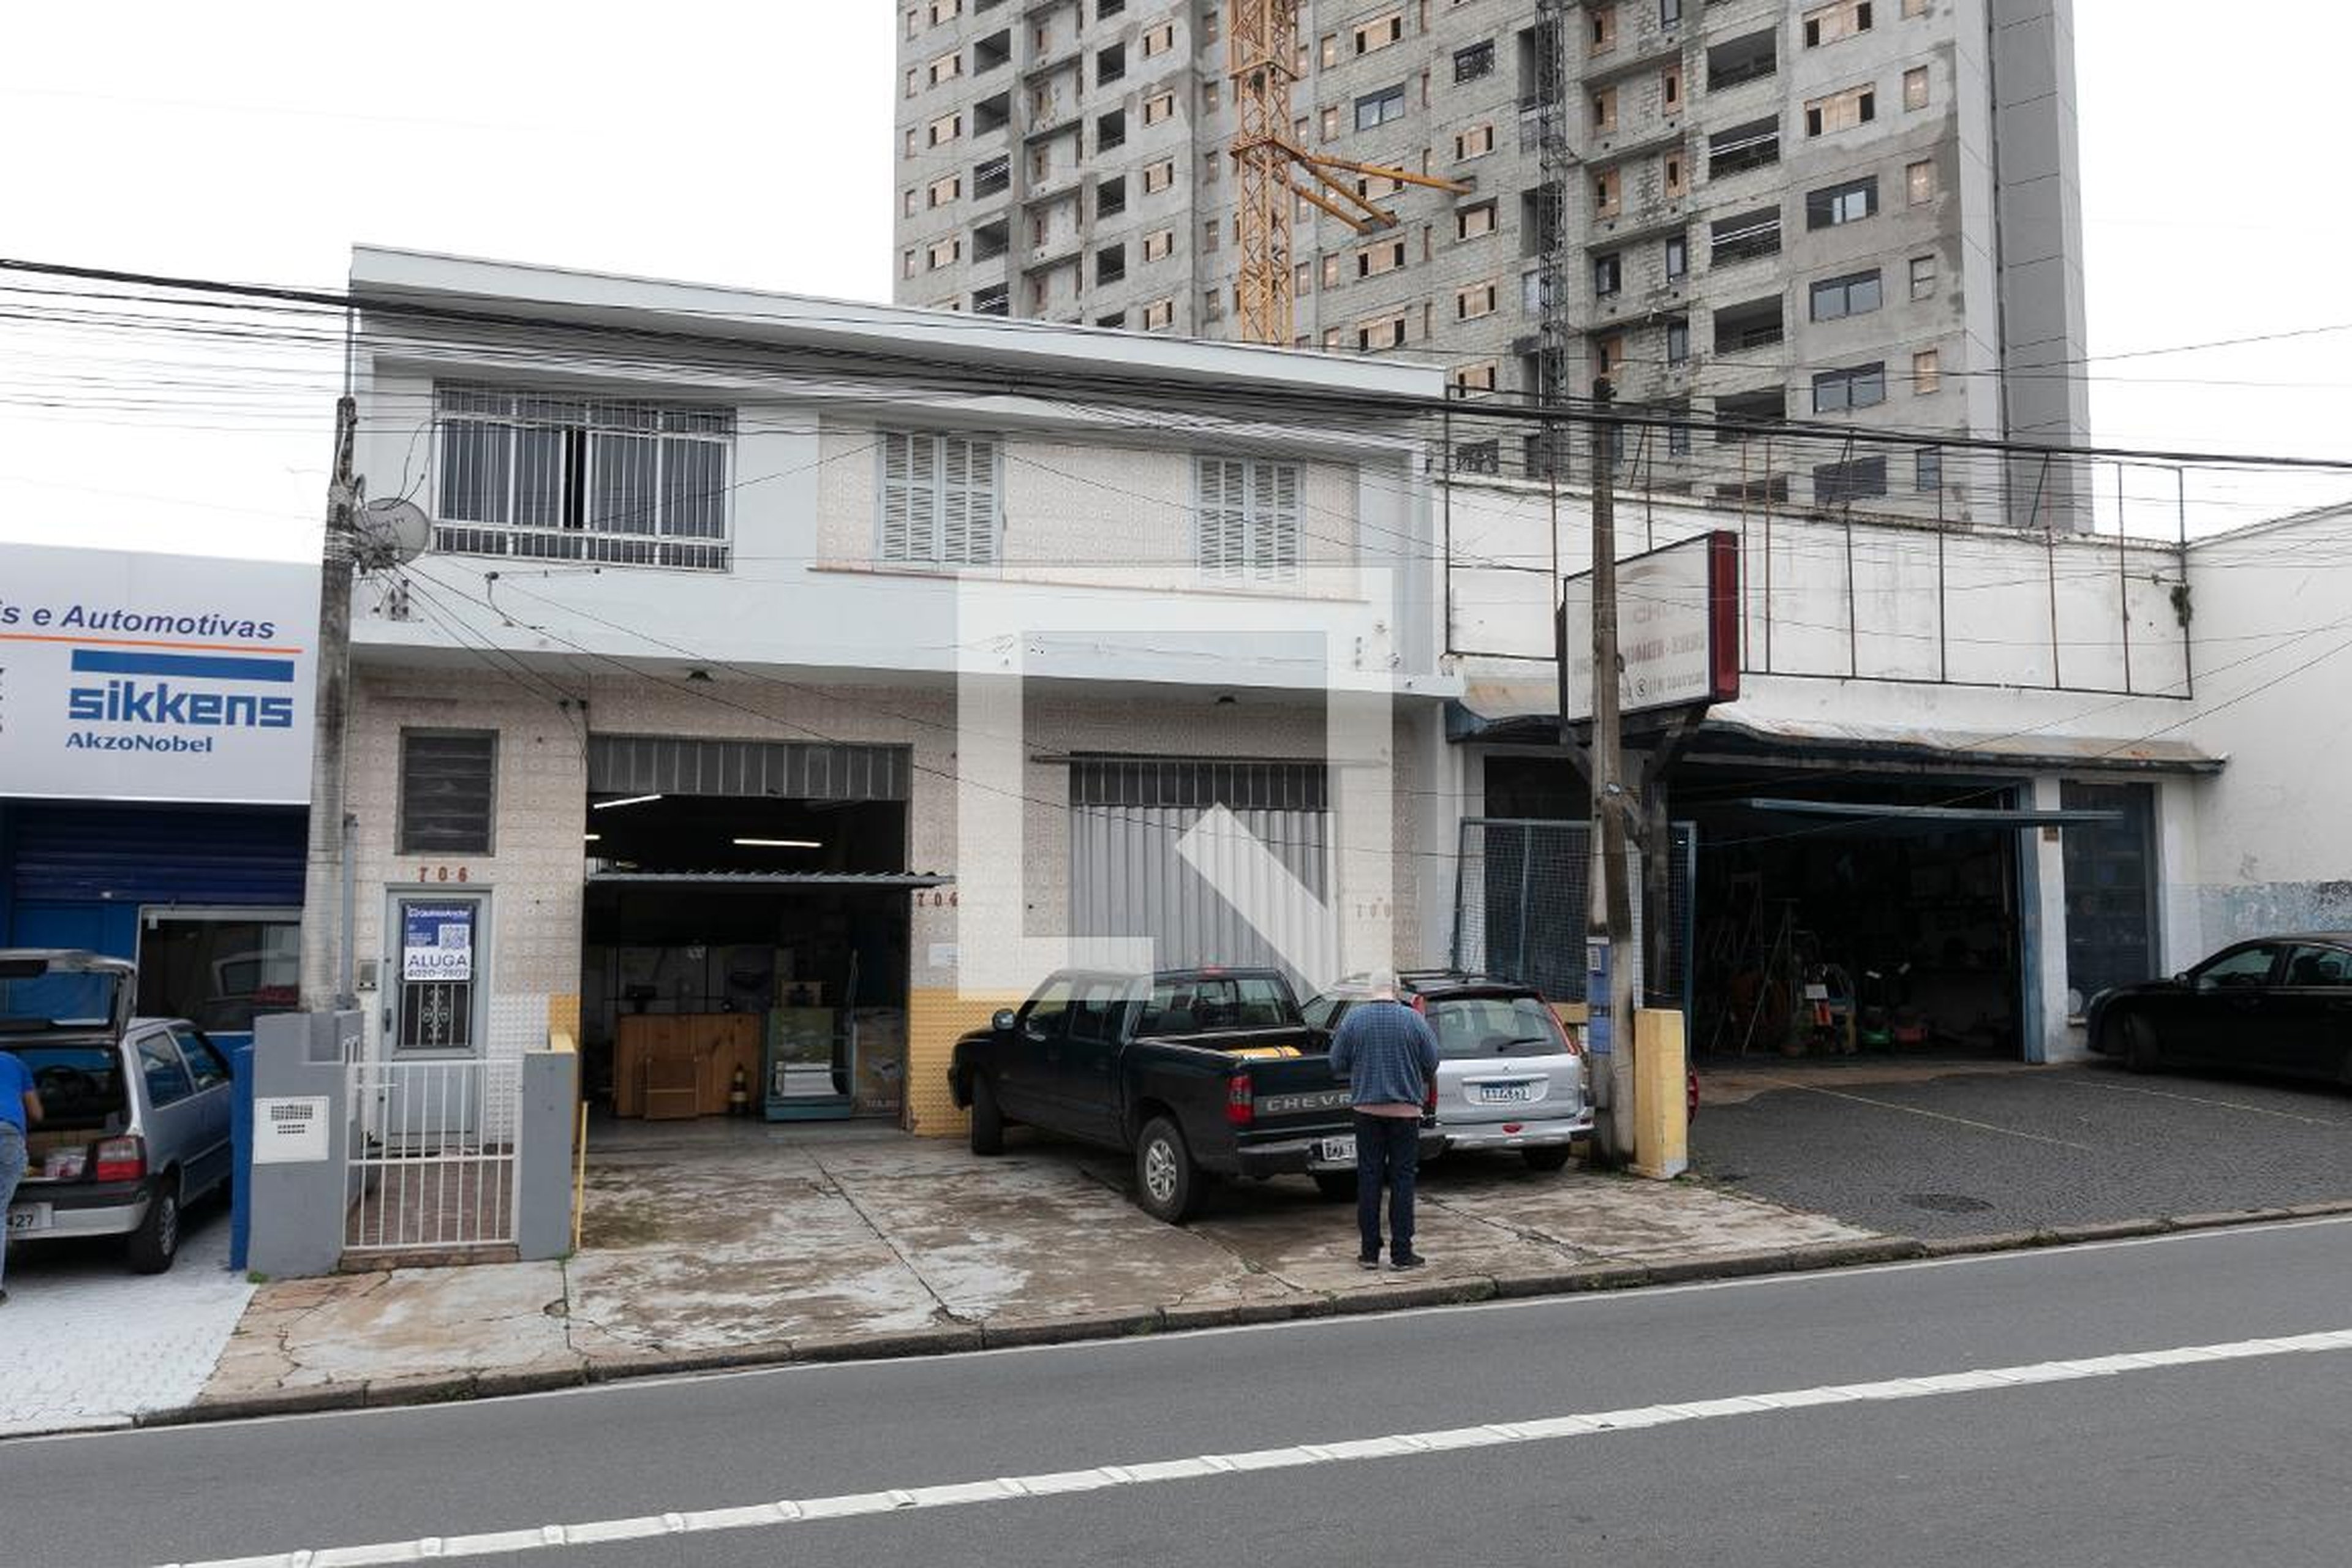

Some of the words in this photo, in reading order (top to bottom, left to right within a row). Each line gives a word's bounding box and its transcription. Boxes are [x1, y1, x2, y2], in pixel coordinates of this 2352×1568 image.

[0, 600, 20, 624] s
[32, 608, 52, 626] e
[62, 605, 276, 639] Automotivas
[69, 680, 293, 727] sikkens
[66, 733, 213, 752] AkzoNobel
[407, 954, 468, 967] ALUGA
[1266, 1093, 1354, 1112] CHEVR
